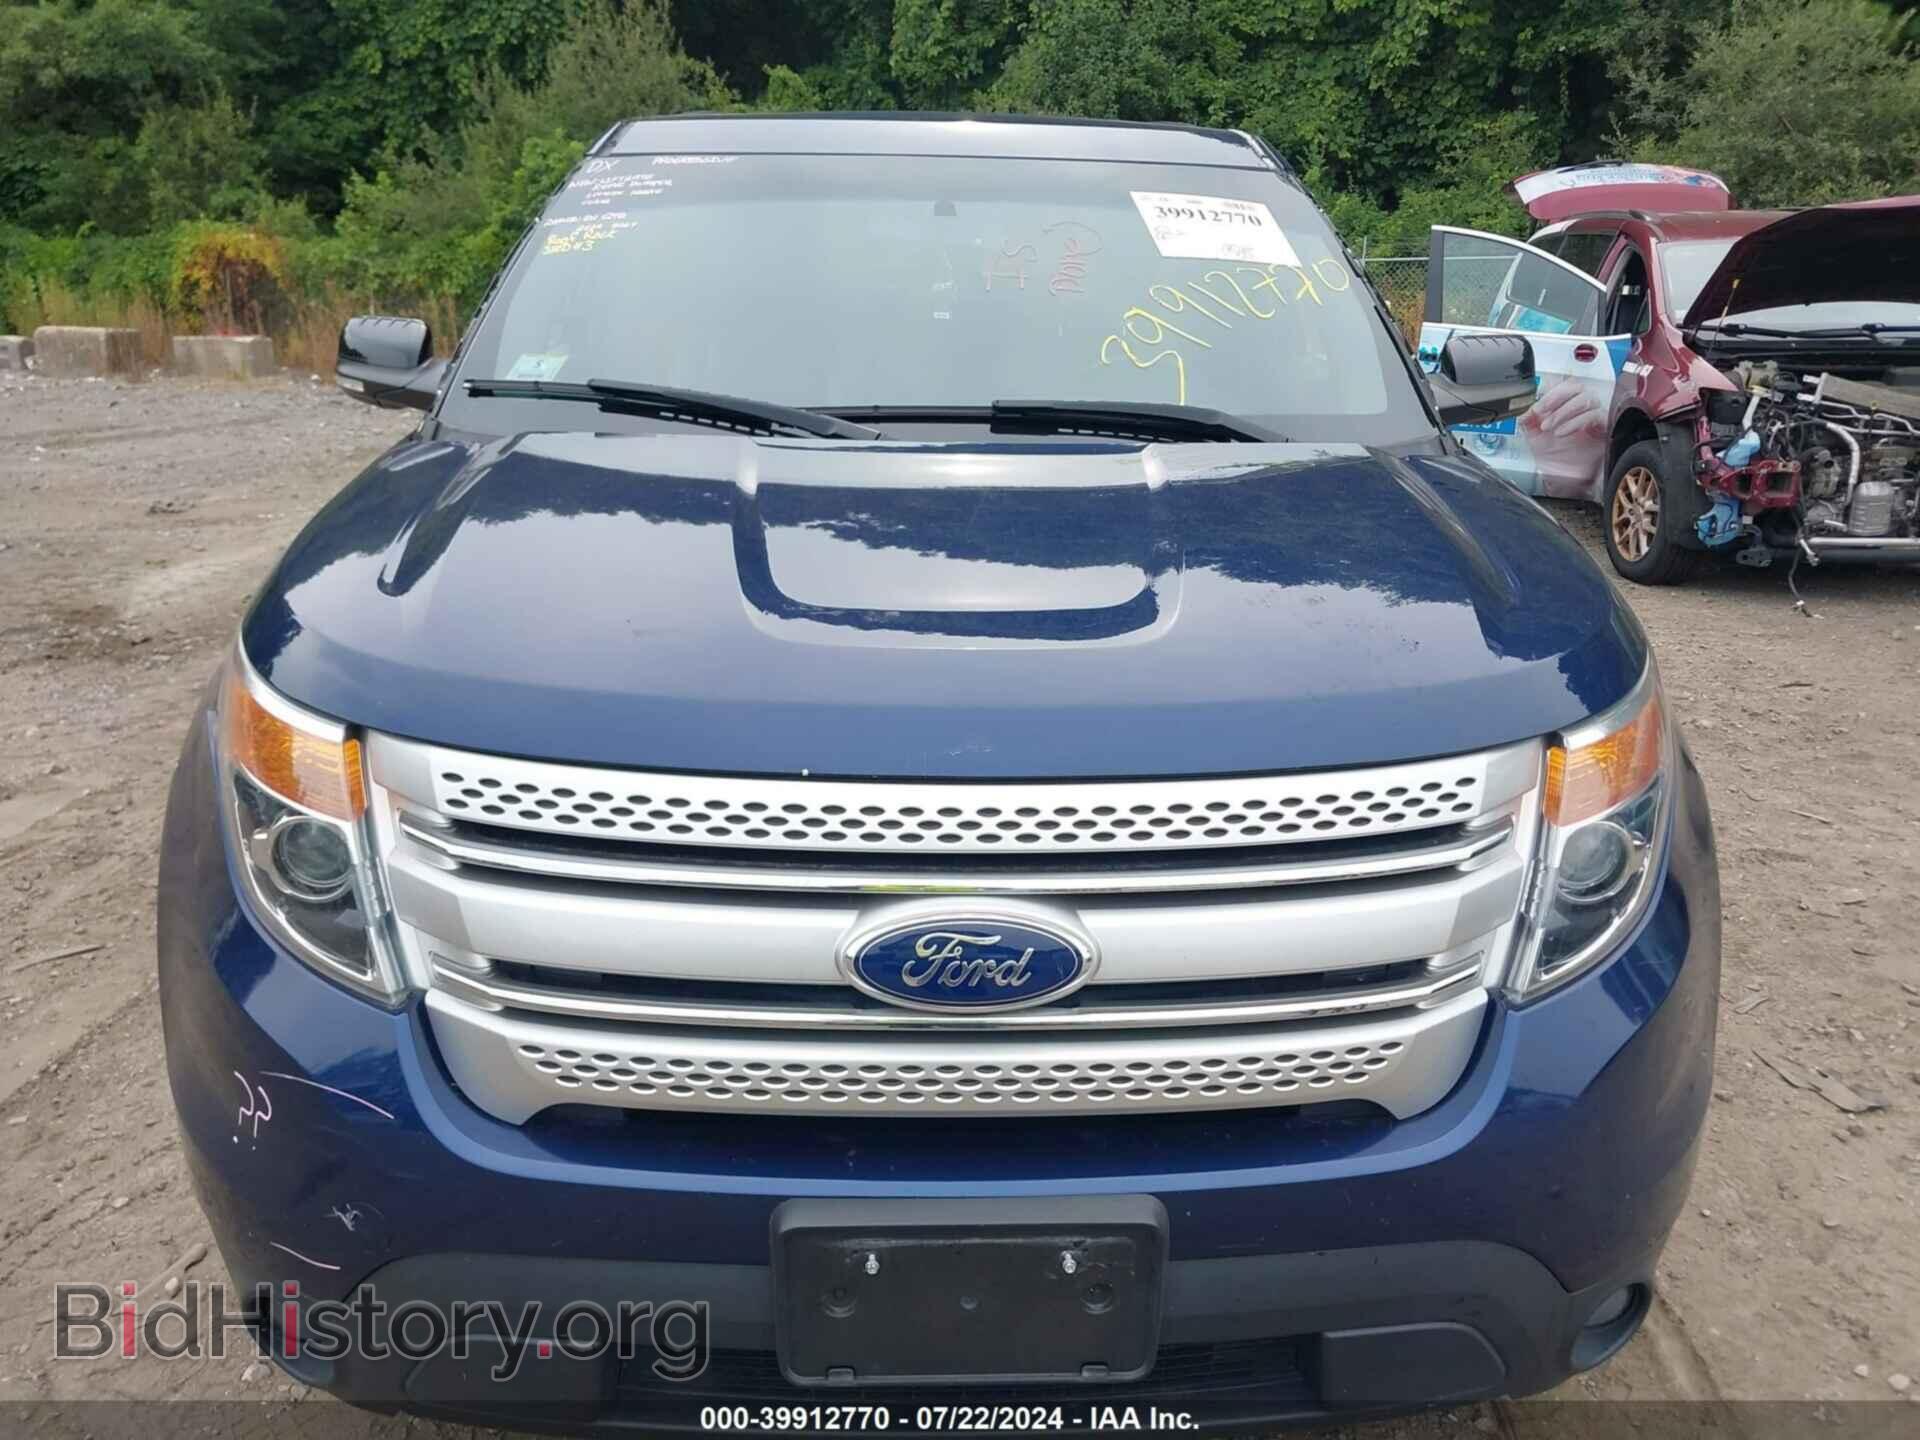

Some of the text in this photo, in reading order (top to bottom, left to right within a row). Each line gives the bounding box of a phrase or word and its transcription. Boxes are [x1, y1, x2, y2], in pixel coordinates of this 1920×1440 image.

[1153, 206, 1263, 227] 39912770
[1101, 257, 1350, 406] 39912770
[901, 931, 1034, 987] Ford
